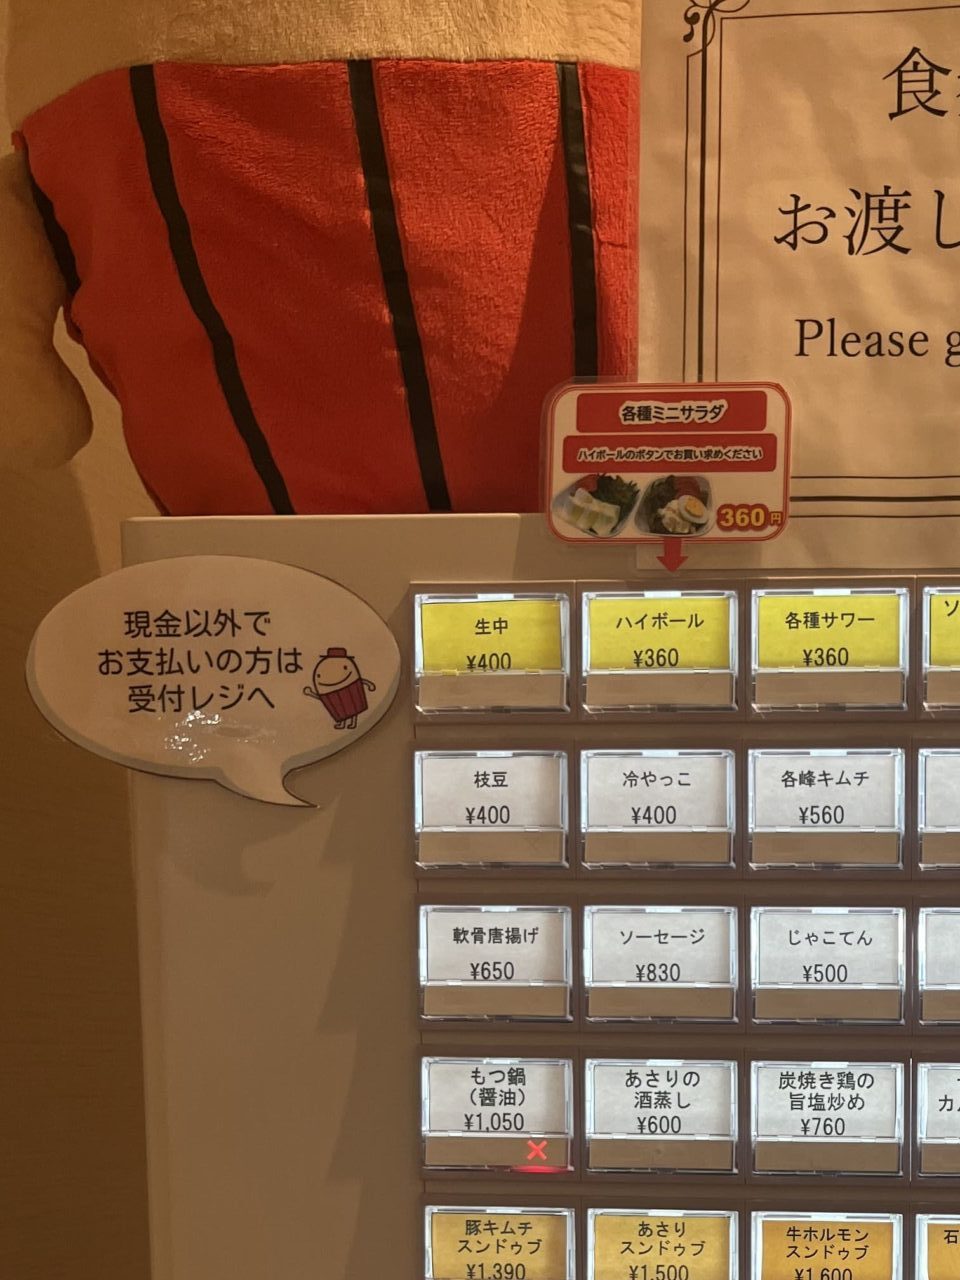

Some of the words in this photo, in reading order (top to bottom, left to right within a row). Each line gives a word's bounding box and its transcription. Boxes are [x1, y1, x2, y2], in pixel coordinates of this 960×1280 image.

[795, 317, 930, 359] Please
[621, 403, 724, 422] 各種ミニサラダ
[577, 448, 762, 460] ハイボールのボタンでお買い求めください
[123, 608, 272, 638] 現金以外で
[475, 618, 508, 635] 生中
[616, 612, 704, 630] ハイボール
[785, 612, 874, 629] 各種サワー
[97, 646, 304, 676] お支払いの方は
[633, 648, 679, 668] ¥360
[803, 648, 848, 667] ¥360
[128, 684, 275, 713] 受付レジへ
[474, 771, 508, 788] 枝豆
[623, 771, 690, 788] 冷やっこ
[466, 805, 510, 824] ¥400
[632, 806, 676, 824] ¥400
[799, 805, 844, 824] ¥560
[621, 929, 704, 944] ソーセージ
[789, 930, 872, 945] じゃこてん
[470, 961, 515, 981] ¥650
[635, 962, 682, 982] ¥830
[802, 963, 848, 983] ¥500
[471, 1067, 525, 1086] もつ鍋
[626, 1069, 700, 1088] あさりの
[634, 1091, 690, 1109] 酒蒸し
[636, 1114, 682, 1134] ¥600
[800, 1116, 846, 1136] ¥760
